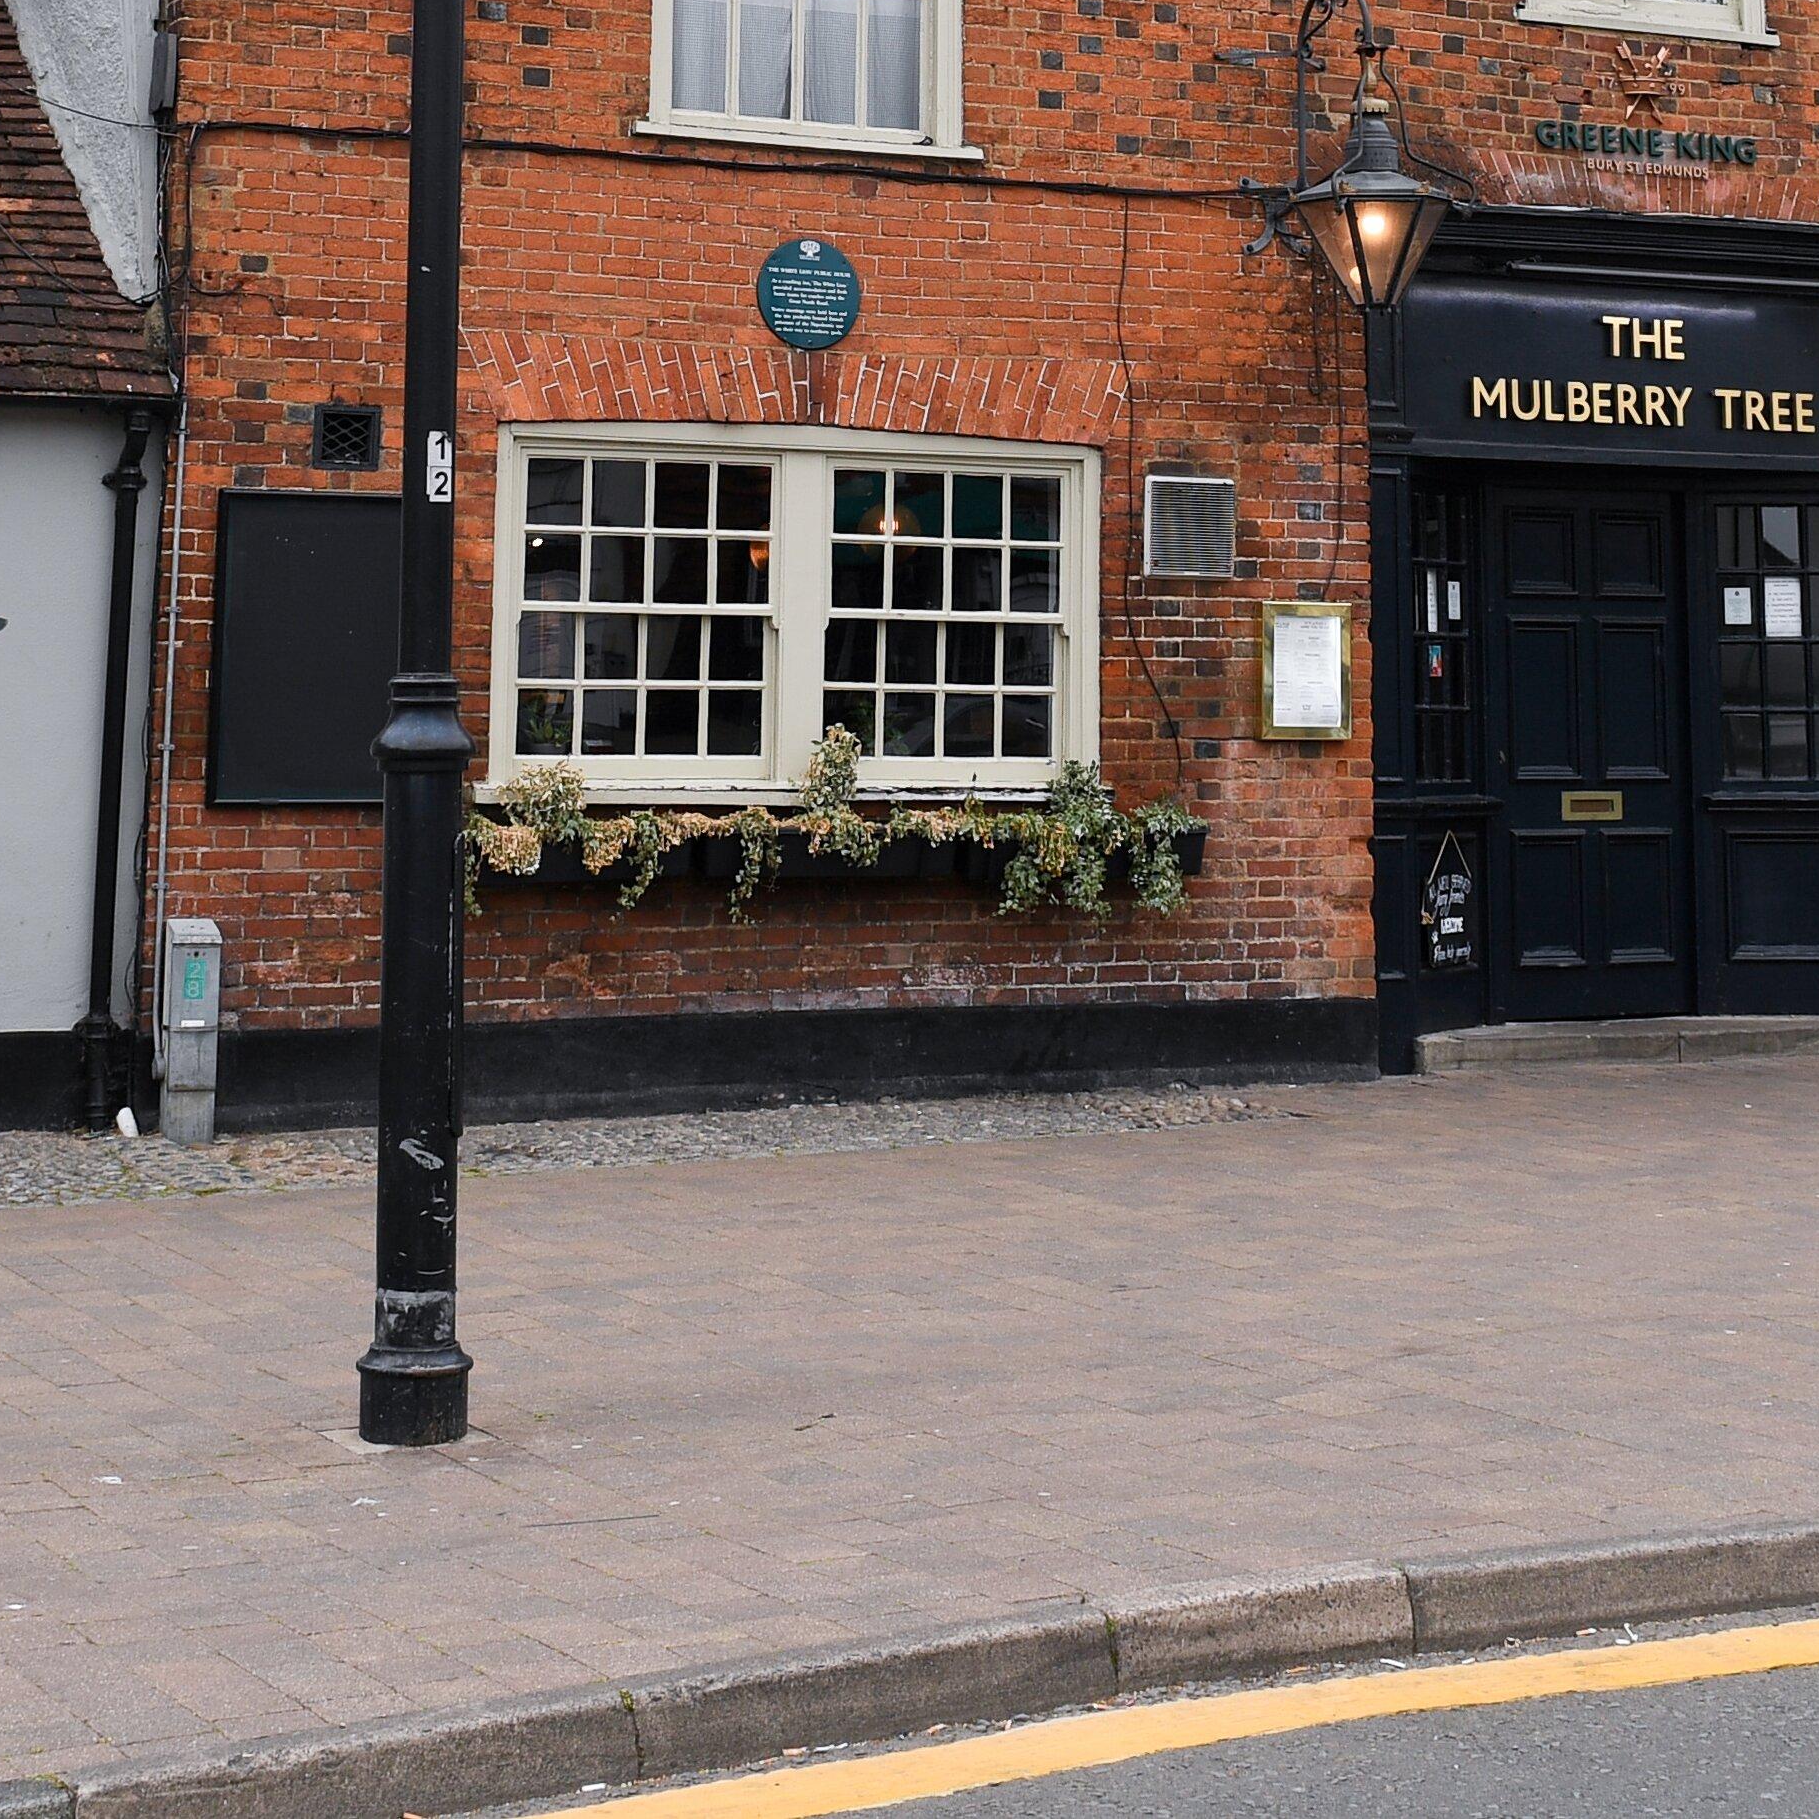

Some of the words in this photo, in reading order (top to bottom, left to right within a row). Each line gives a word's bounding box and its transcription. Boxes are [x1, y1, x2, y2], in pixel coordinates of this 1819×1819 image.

[1536, 120, 1664, 157] GREENE
[1675, 132, 1758, 165] KING
[1587, 157, 1622, 173] BURY
[1626, 161, 1640, 173] ST
[1645, 162, 1709, 179] EDMUNDS
[1601, 315, 1686, 361] THE
[1472, 376, 1693, 428] MULBERRY
[1714, 388, 1816, 433] TREE
